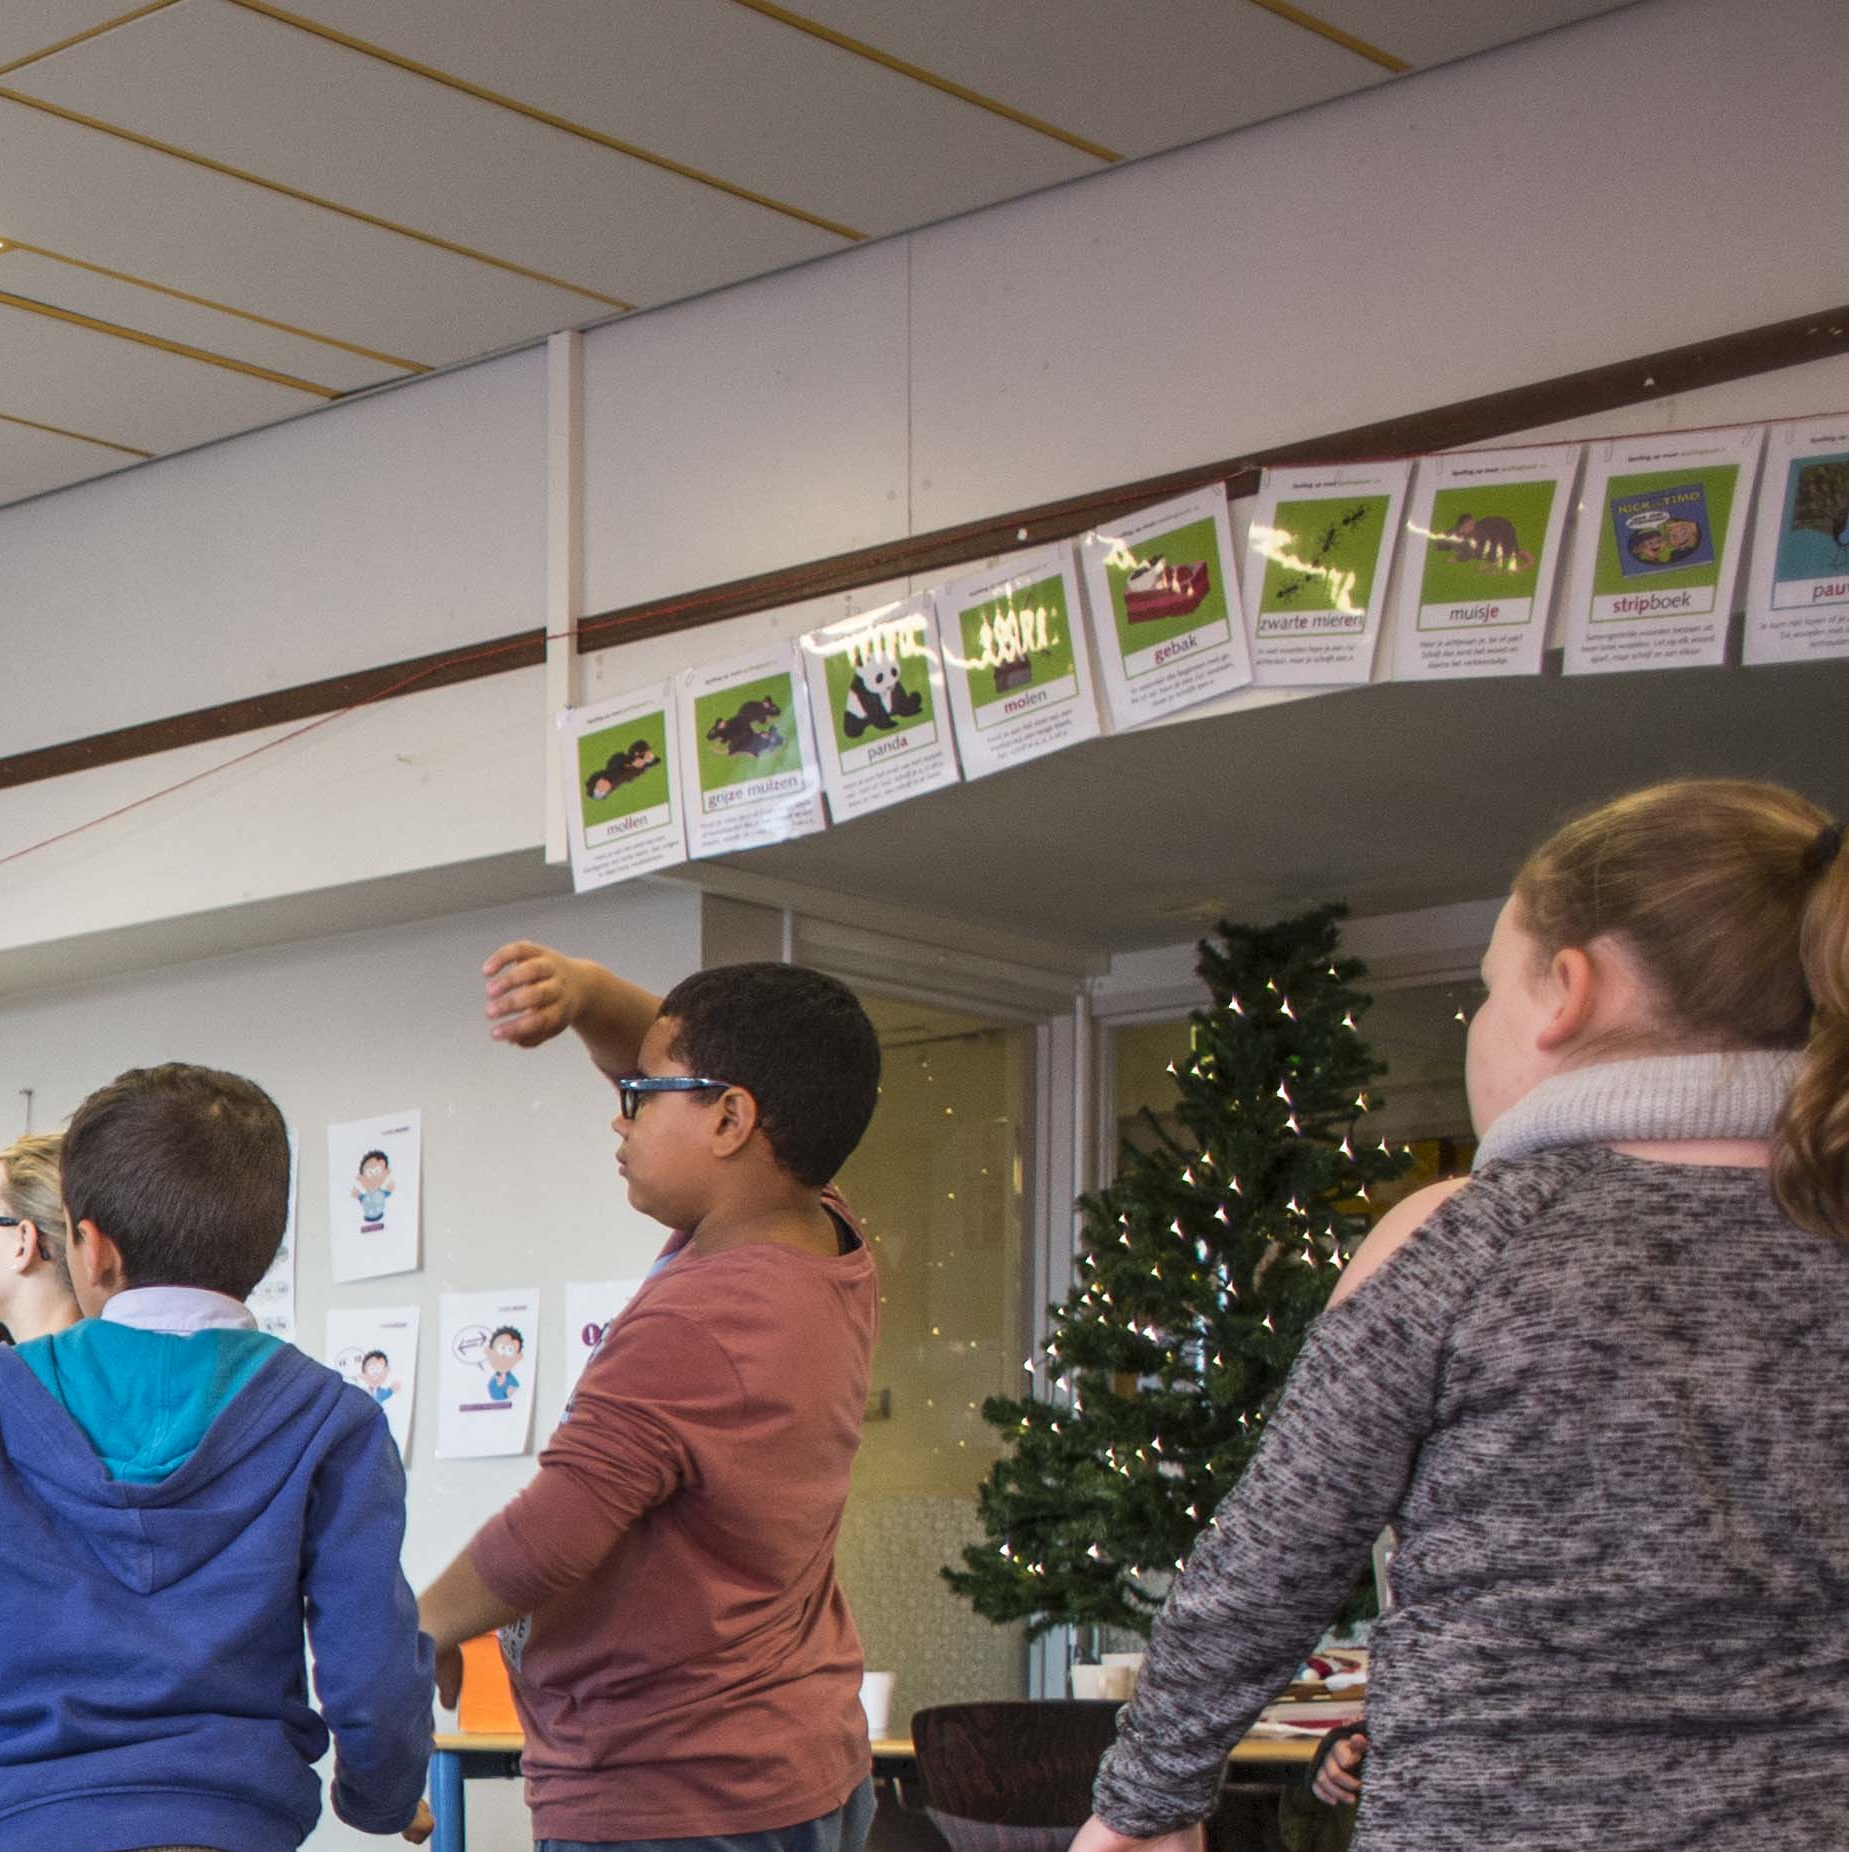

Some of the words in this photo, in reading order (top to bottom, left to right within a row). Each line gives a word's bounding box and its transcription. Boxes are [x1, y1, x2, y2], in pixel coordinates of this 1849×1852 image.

[1449, 604, 1501, 624] muisje
[1613, 590, 1692, 616] stripboek
[1259, 616, 1309, 632] zwarte
[1311, 611, 1364, 630] mieren
[1153, 632, 1198, 665] gebak
[1004, 689, 1048, 715] molen
[867, 734, 909, 763] panda
[707, 788, 744, 810] grijze
[747, 775, 799, 798] muizen
[606, 813, 649, 836] mollen
